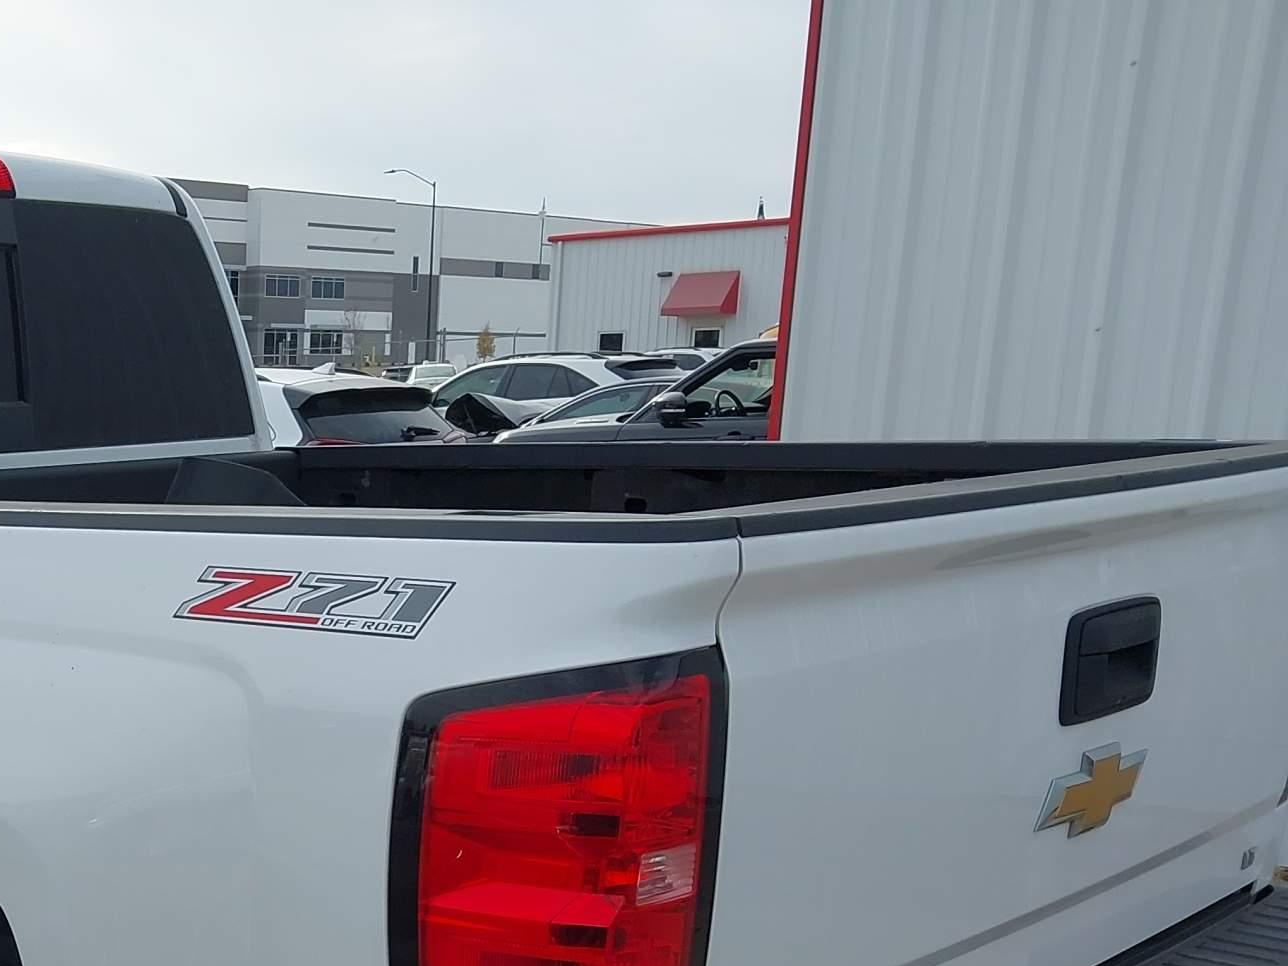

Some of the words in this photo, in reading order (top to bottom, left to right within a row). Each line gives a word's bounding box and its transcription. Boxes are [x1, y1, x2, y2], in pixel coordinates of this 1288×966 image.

[173, 565, 457, 638] Z71
[321, 617, 358, 631] OFF
[359, 620, 418, 635] ROAD
